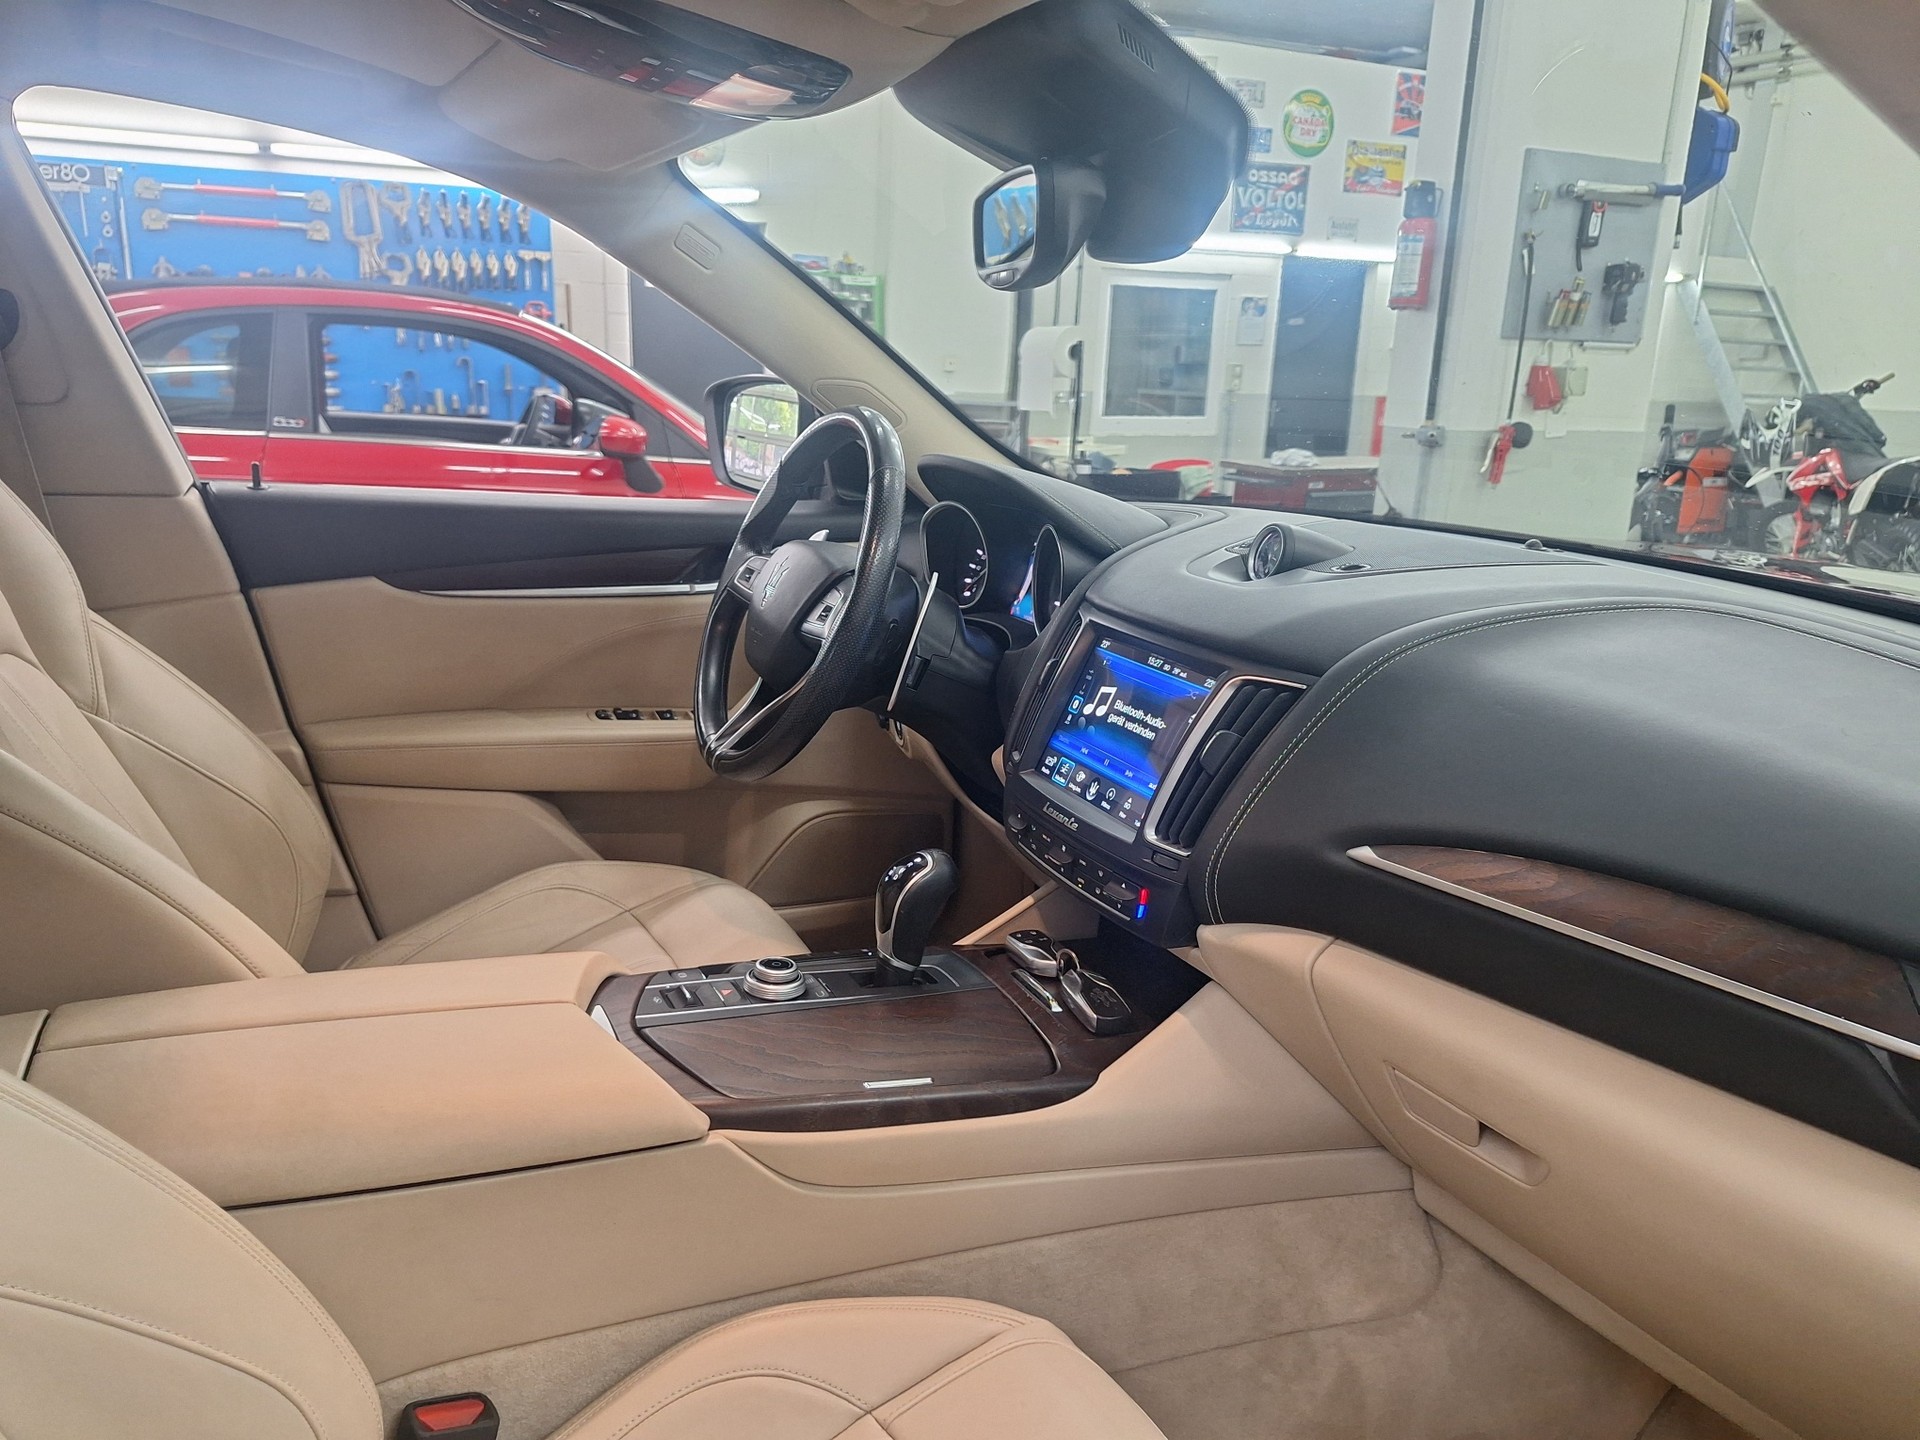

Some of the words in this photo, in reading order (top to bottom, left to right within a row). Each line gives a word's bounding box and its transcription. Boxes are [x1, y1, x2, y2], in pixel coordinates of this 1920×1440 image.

[1292, 116, 1328, 127] CANADA
[1299, 127, 1317, 136] DRY
[1236, 186, 1305, 210] VOLTOL
[1147, 656, 1163, 668] 15:27
[1113, 699, 1167, 729] Bluetooth-Audio-
[1106, 713, 1126, 728] gerät
[1124, 718, 1156, 740] verbinden
[1042, 802, 1079, 832] Levante
